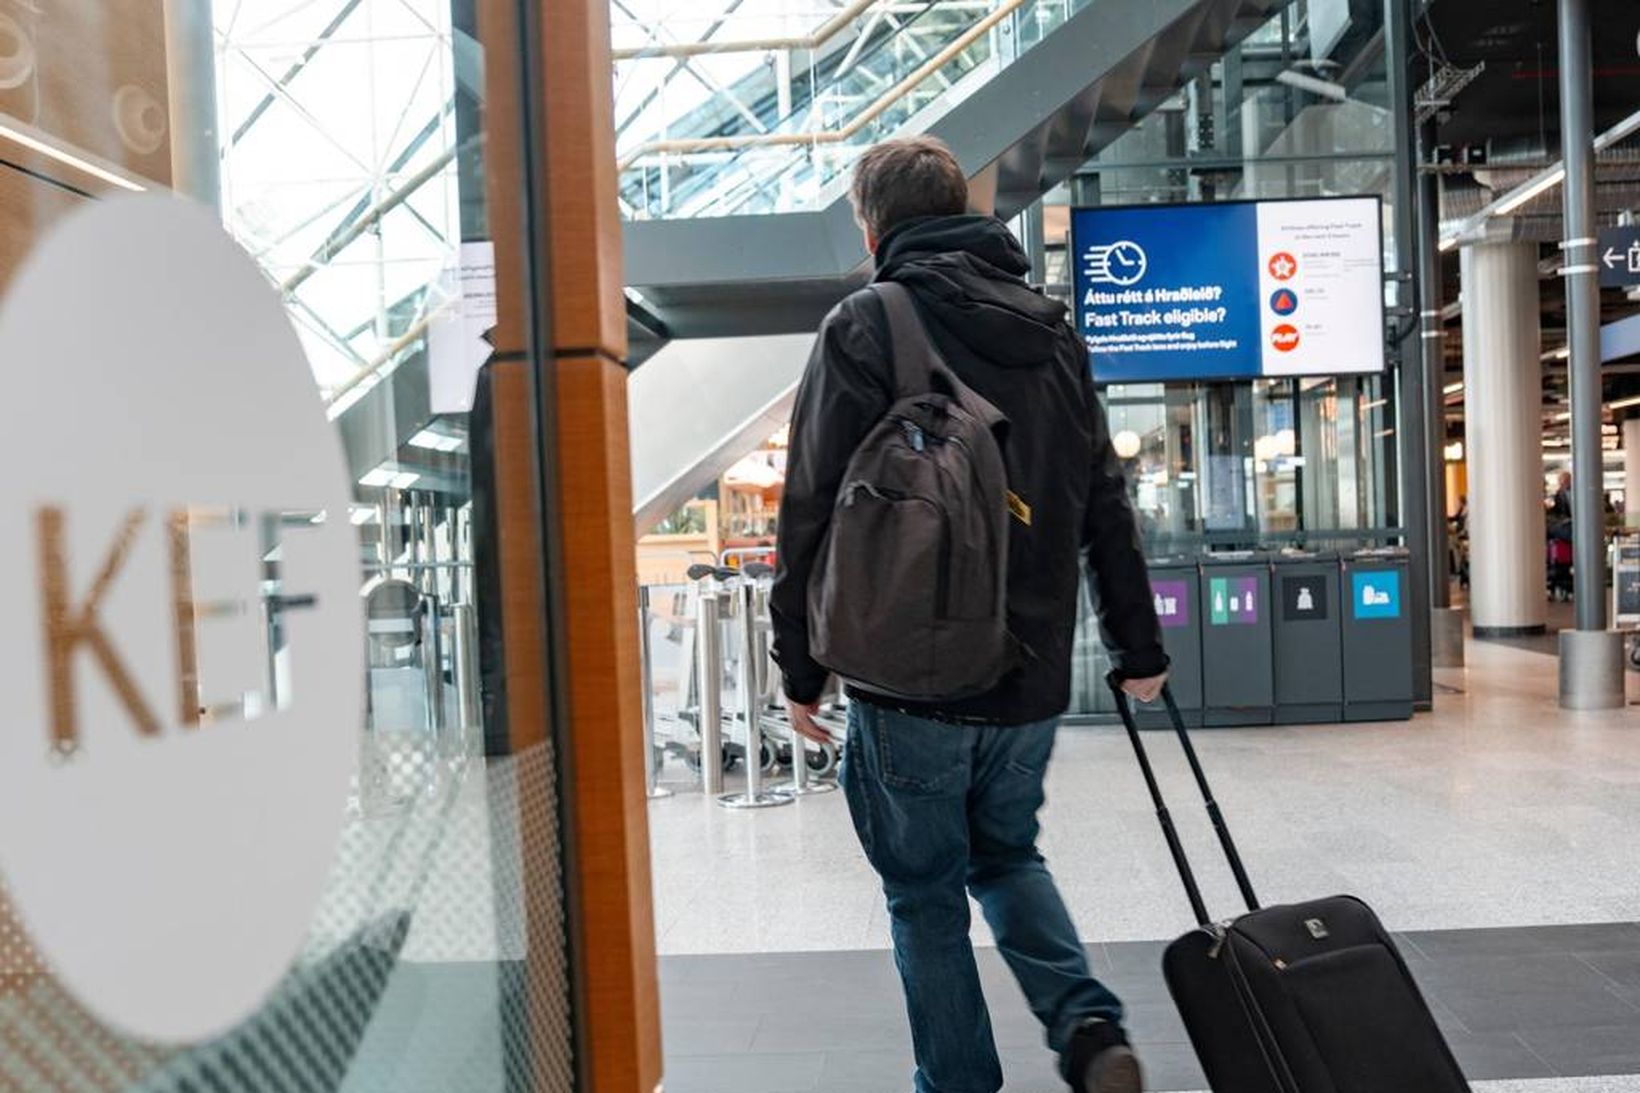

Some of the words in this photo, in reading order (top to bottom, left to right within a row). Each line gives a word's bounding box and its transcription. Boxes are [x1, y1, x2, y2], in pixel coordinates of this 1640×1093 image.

[1084, 288, 1115, 306] Áttu
[1116, 289, 1143, 304] rétt
[1144, 288, 1153, 304] á
[1085, 312, 1118, 327] Fast
[1119, 309, 1162, 326] Track
[1163, 307, 1226, 327] eligible?
[36, 502, 328, 743] KEF
